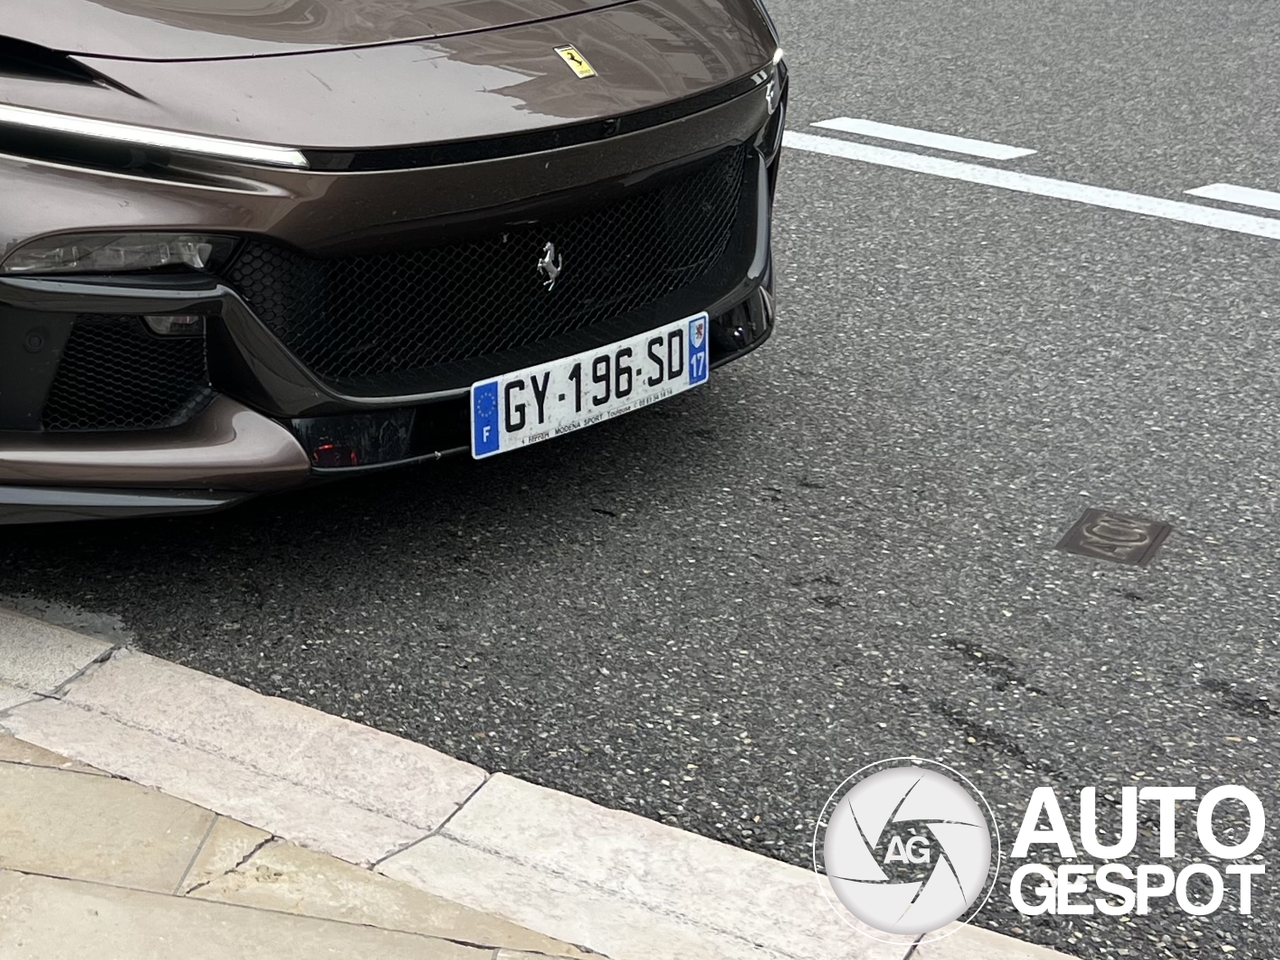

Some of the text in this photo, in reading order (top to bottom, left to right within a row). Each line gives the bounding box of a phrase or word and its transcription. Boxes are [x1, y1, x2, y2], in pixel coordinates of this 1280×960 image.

[690, 350, 705, 378] 17
[583, 413, 603, 426] SPORT
[482, 425, 491, 443] F
